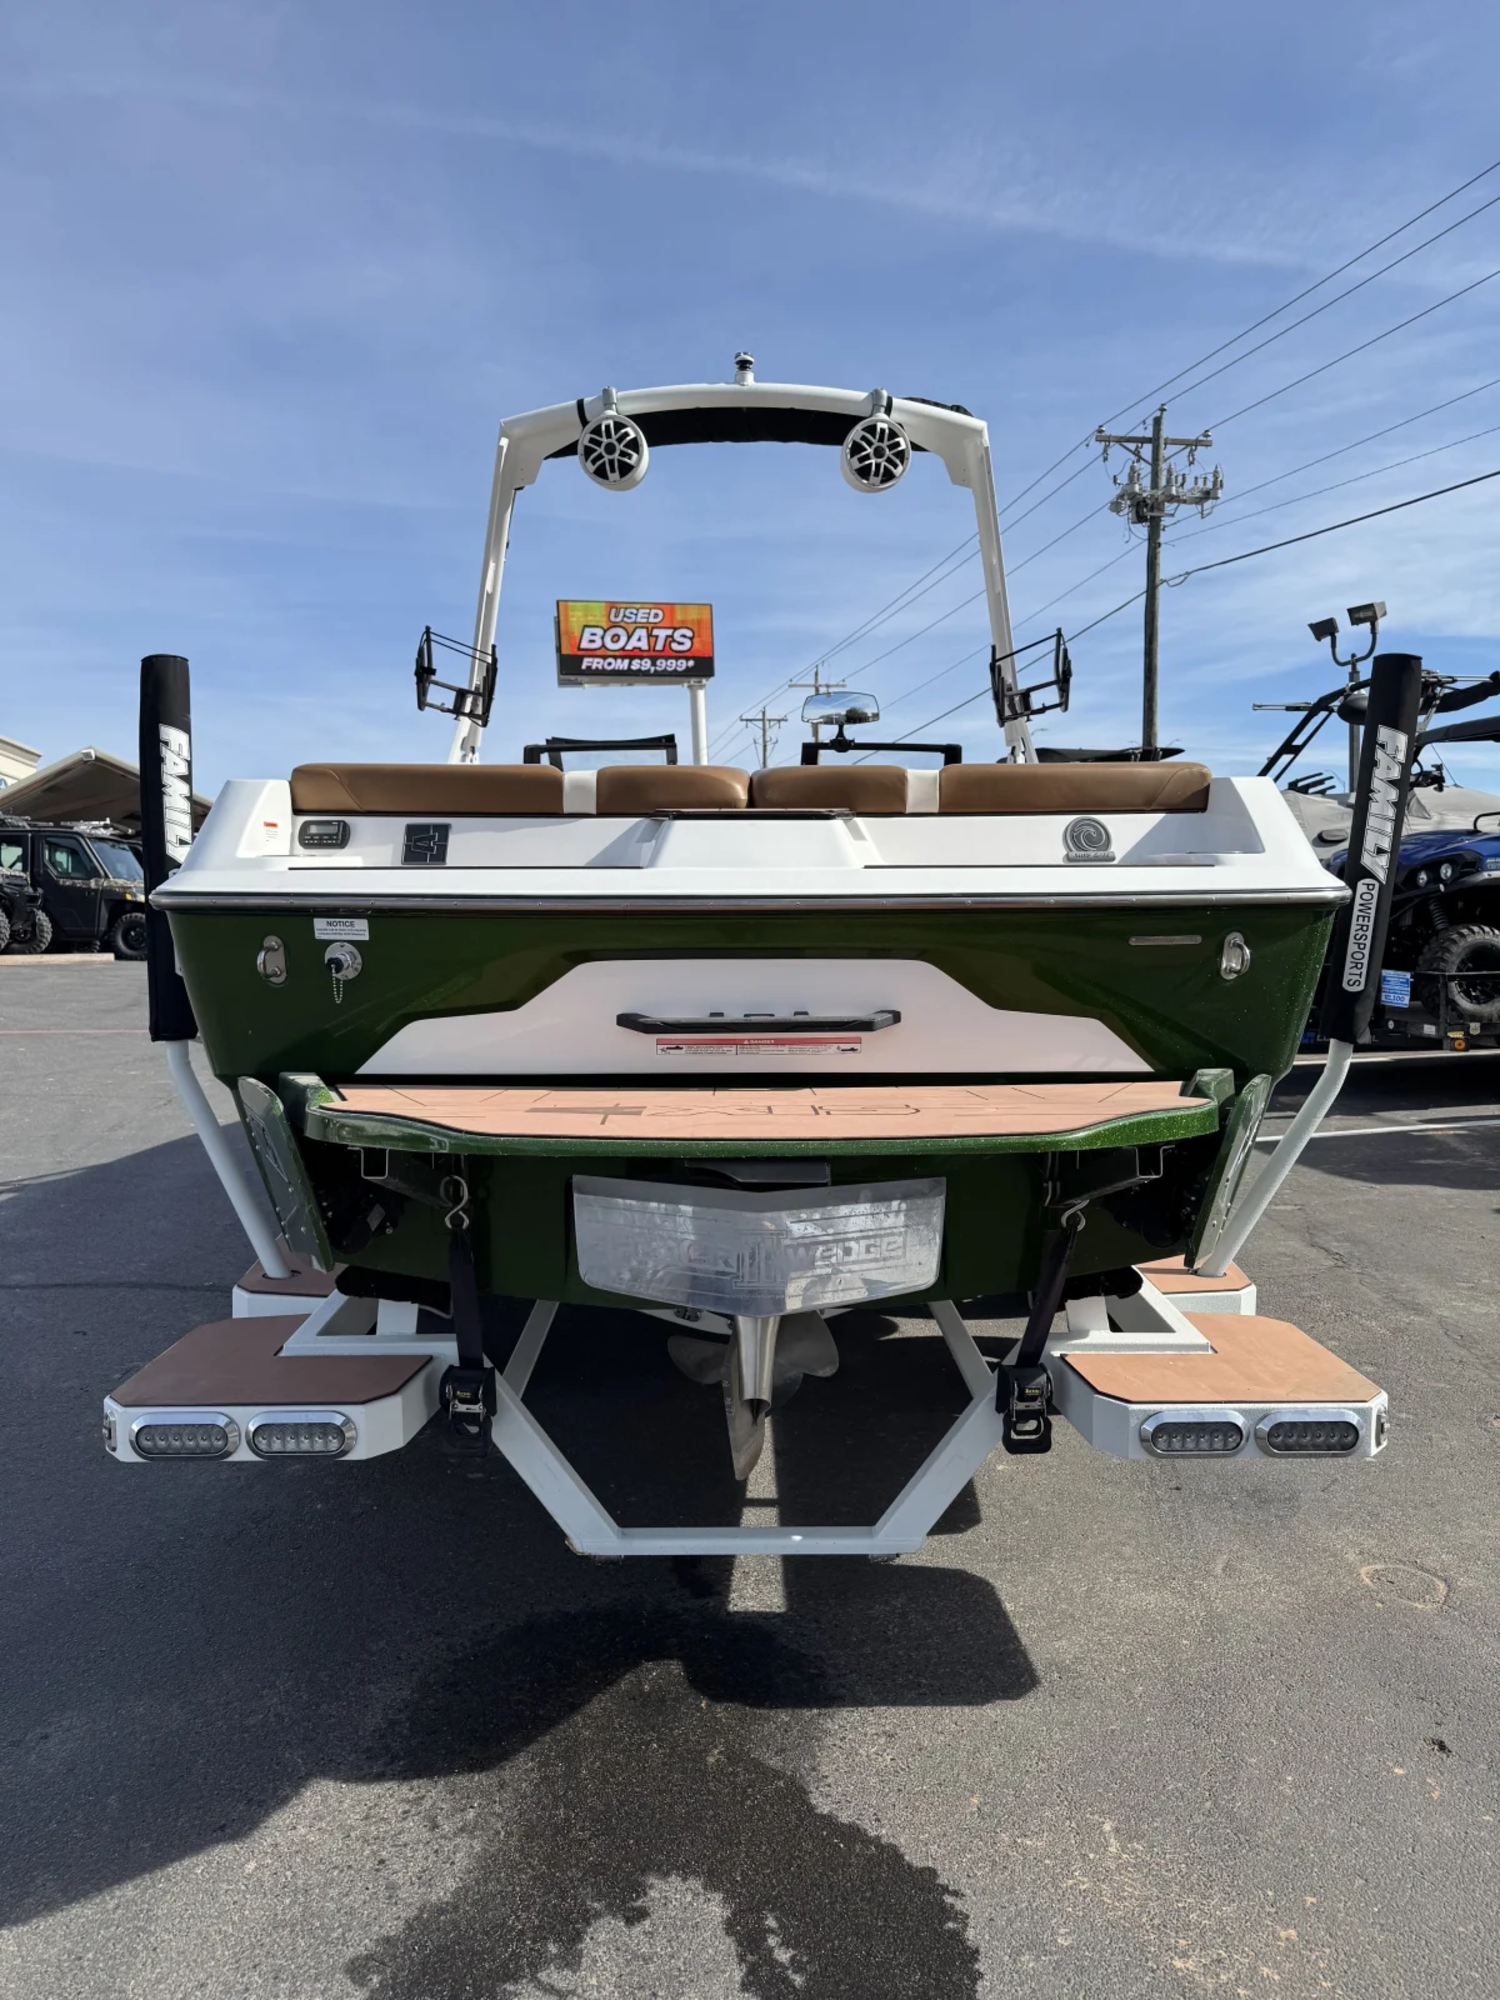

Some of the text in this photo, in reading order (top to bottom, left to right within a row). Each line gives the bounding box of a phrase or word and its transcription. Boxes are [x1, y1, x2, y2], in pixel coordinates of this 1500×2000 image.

[609, 608, 663, 623] USED
[578, 626, 694, 652] BOATS
[581, 657, 629, 670] FROM
[1360, 724, 1408, 885] FAMILY
[326, 920, 356, 928] NOTICE
[1347, 882, 1376, 989] POWERSPORTS
